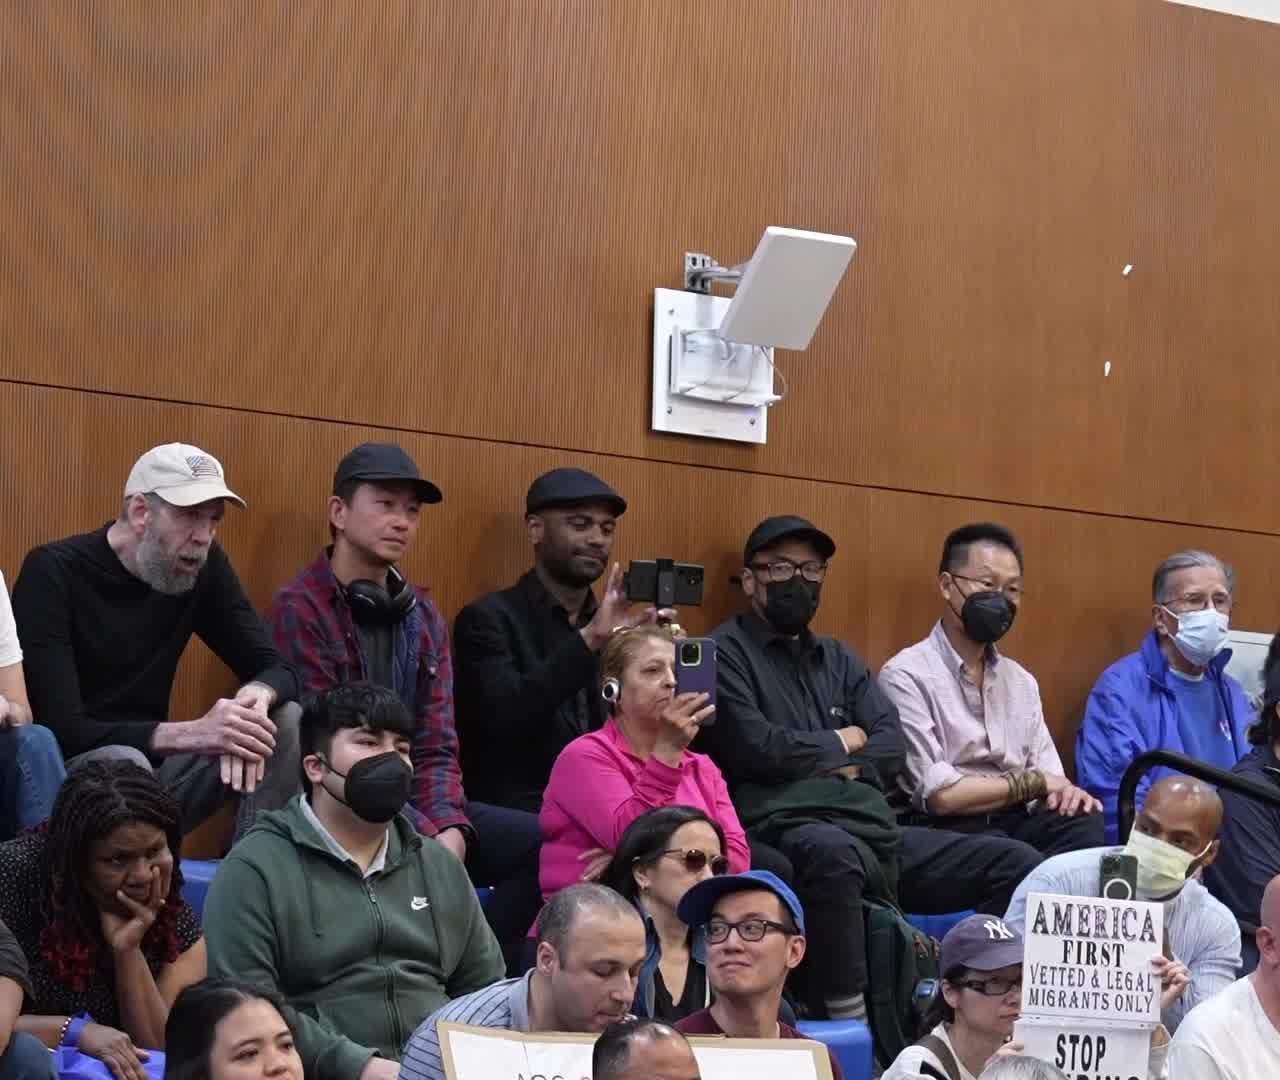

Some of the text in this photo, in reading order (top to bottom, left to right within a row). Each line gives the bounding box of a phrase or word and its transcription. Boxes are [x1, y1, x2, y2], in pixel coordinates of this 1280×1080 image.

[1031, 900, 1157, 943] AMERICA
[1062, 939, 1125, 968] FIRST
[1030, 961, 1154, 993] VETTED & LEGAL
[1028, 987, 1155, 1014] MIGRANTS ONLY
[1055, 1033, 1107, 1072] STOP
